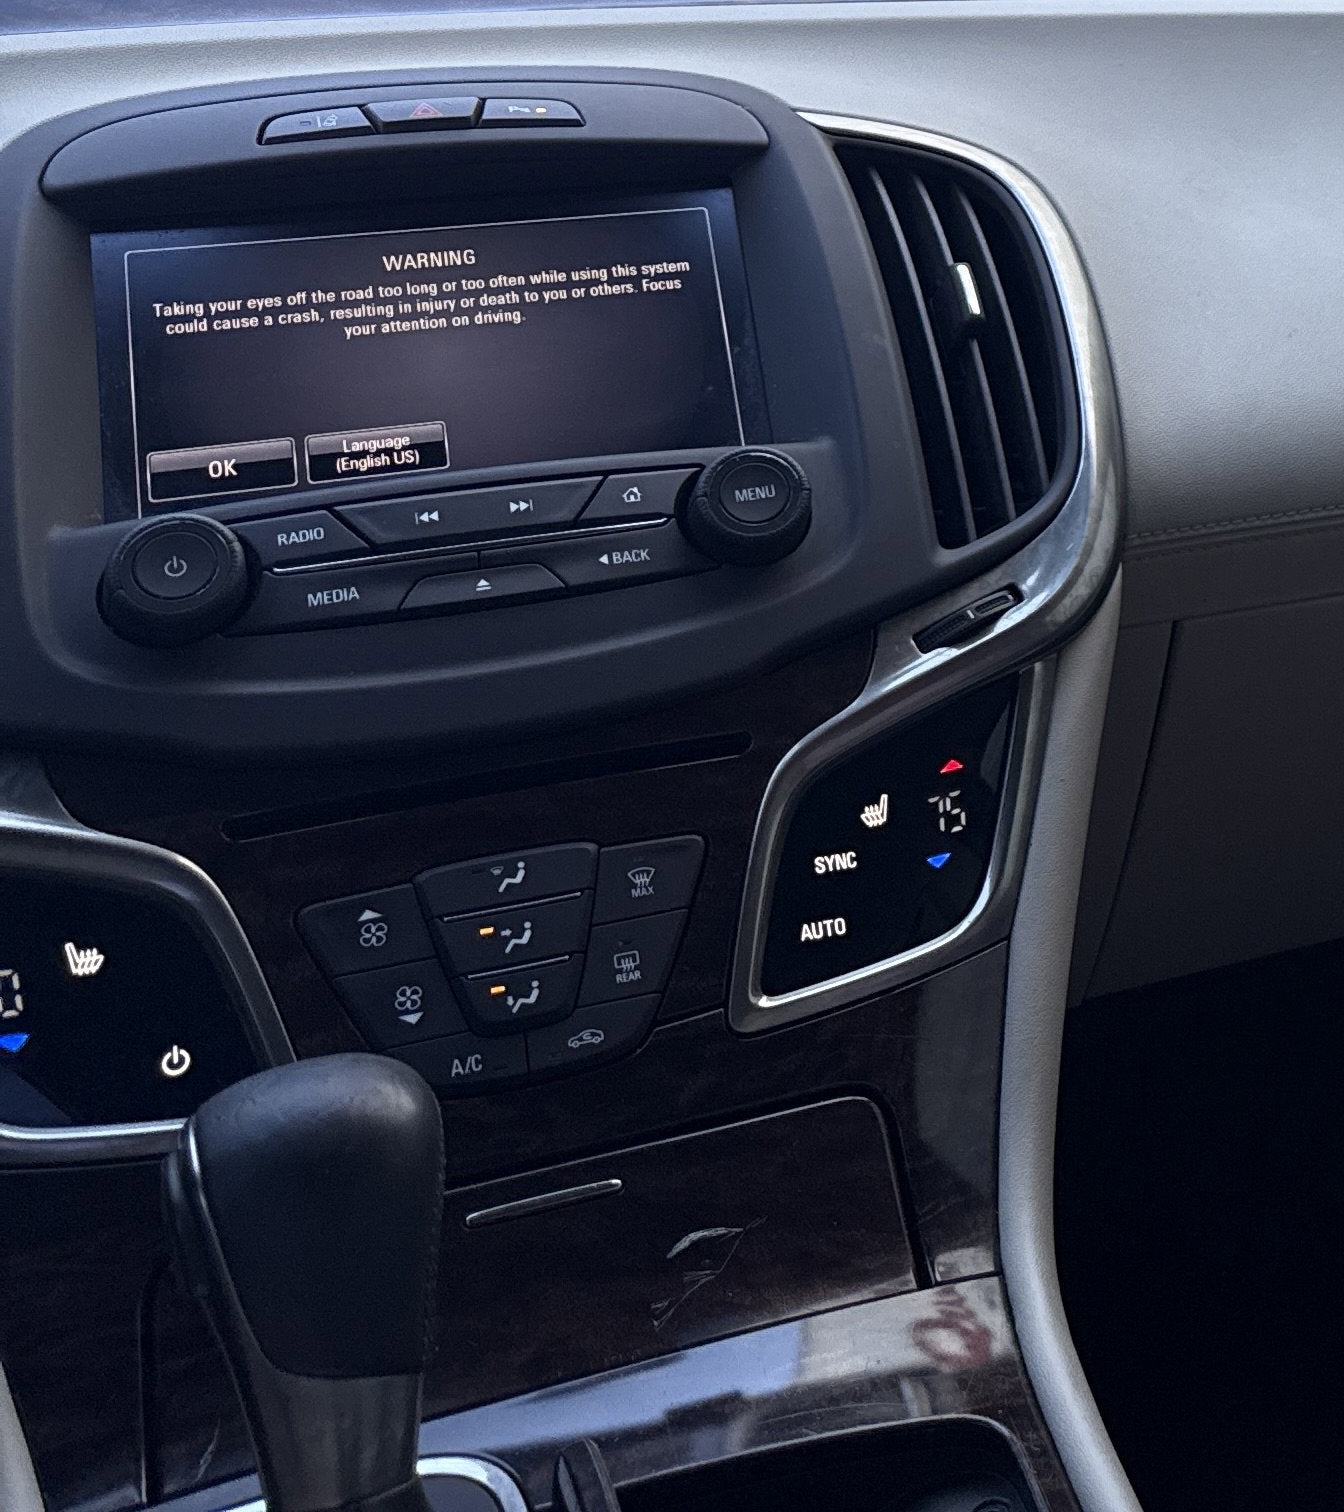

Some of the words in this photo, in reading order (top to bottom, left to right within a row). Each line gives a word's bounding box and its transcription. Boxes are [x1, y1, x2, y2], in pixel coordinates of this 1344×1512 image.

[382, 248, 475, 272] WARNING
[153, 299, 203, 319] Taking
[208, 298, 242, 314] your
[246, 295, 282, 311] eyes
[286, 290, 307, 305] off
[310, 288, 335, 303] the
[340, 285, 373, 301] road
[377, 282, 402, 297] too
[406, 279, 437, 297] long
[442, 281, 457, 292] or
[461, 276, 485, 290] too
[489, 272, 525, 288] often
[529, 268, 567, 285] while
[570, 265, 608, 283] using
[611, 262, 637, 278] this
[640, 259, 690, 278] system
[165, 317, 207, 334] could
[212, 316, 258, 330] cause
[263, 315, 273, 326] a
[277, 308, 324, 326] crash,
[329, 302, 394, 322] resulting
[398, 300, 411, 314] in
[416, 296, 456, 315] injury
[459, 297, 475, 308] or
[479, 291, 519, 306] death
[524, 290, 538, 302] to
[542, 288, 567, 304] you
[571, 287, 585, 298] or
[589, 281, 638, 296] others.
[642, 277, 681, 291] Focus
[343, 323, 376, 338] your
[380, 315, 446, 332] attention
[451, 315, 469, 326] on
[474, 308, 526, 327] driving.
[342, 434, 411, 454] Language
[208, 458, 237, 478] OK
[336, 450, 390, 473] (English
[394, 448, 420, 469] US)
[734, 483, 776, 503] MENU
[277, 526, 325, 546] RADIO
[611, 547, 651, 565] BACK
[307, 586, 360, 608] MEDIA
[928, 790, 967, 834] 75
[814, 851, 858, 874] SYNC
[631, 884, 655, 898] MAX
[800, 917, 847, 942] AUTO
[615, 969, 642, 984] REAR
[450, 1052, 483, 1078] A/C
